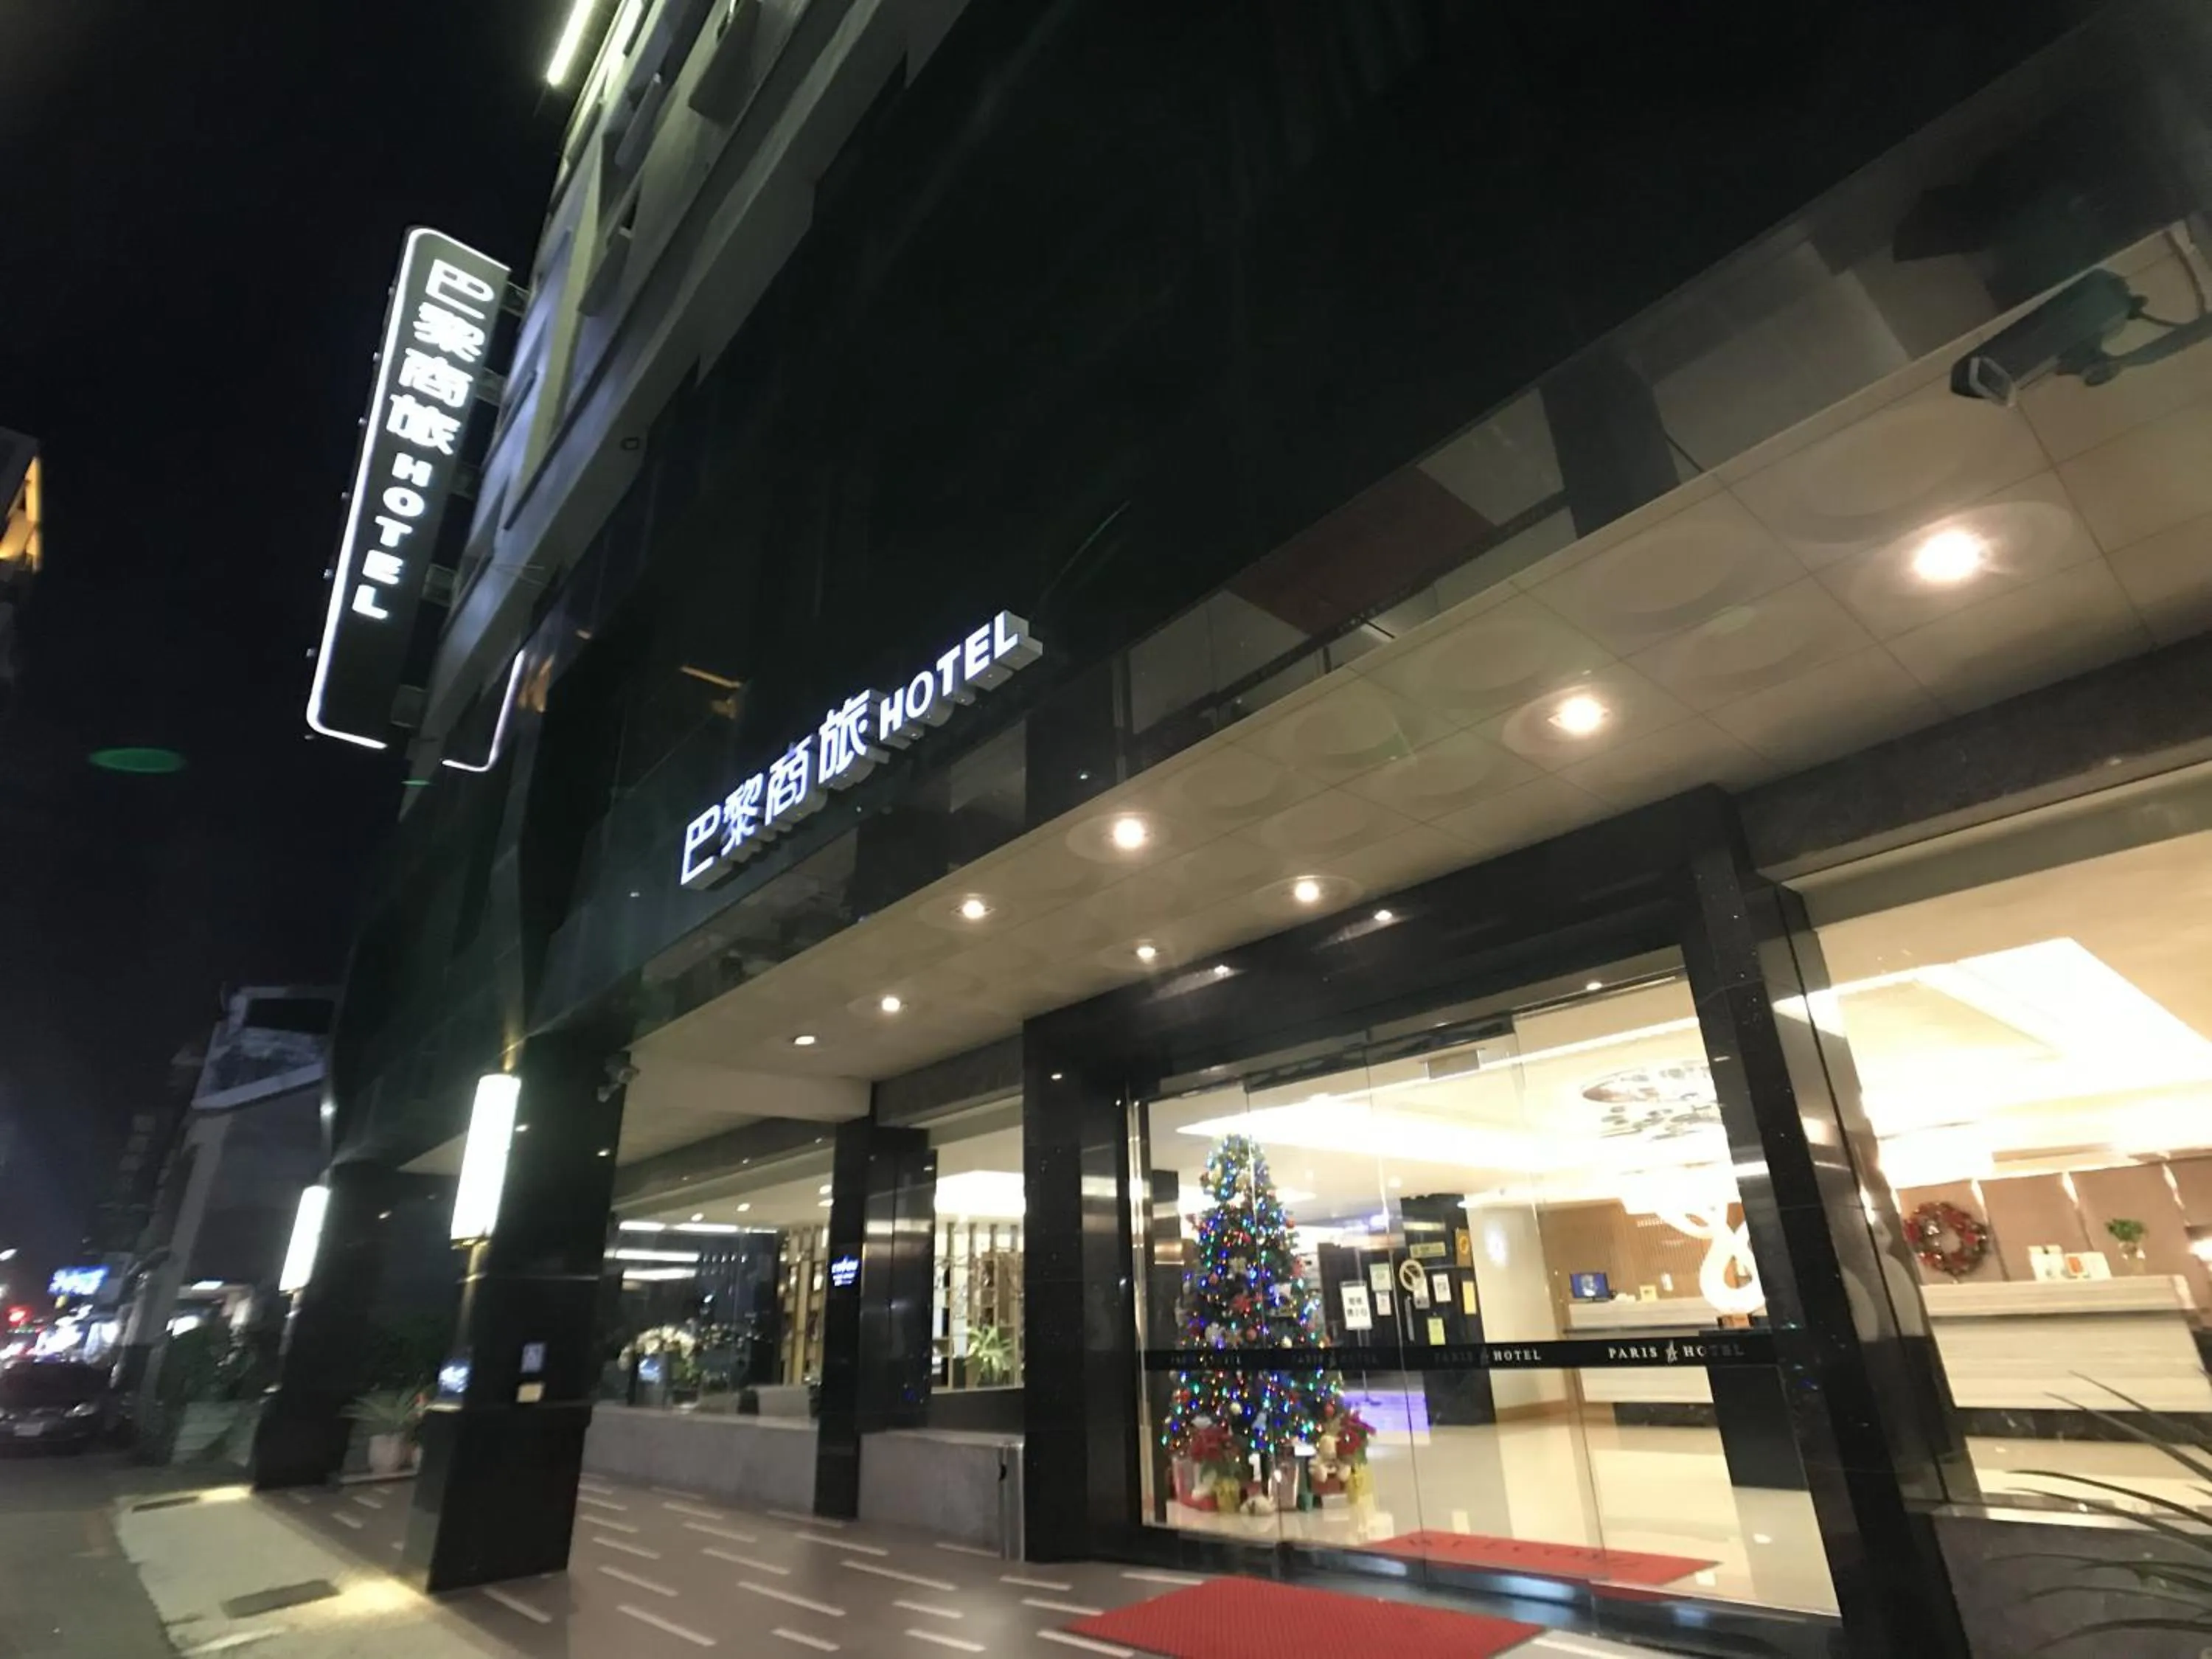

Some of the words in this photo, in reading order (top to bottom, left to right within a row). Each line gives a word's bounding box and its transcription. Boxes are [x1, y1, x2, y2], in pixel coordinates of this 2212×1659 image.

[386, 259, 495, 455] 巴黎商旅
[352, 452, 433, 619] HOTEL
[680, 688, 871, 886] 巴黎商旅
[879, 611, 1019, 741] HOTEL
[1492, 1349, 1542, 1362] HOTEL
[1607, 1346, 1658, 1360] PARIS
[1682, 1343, 1746, 1358] HOTEL
